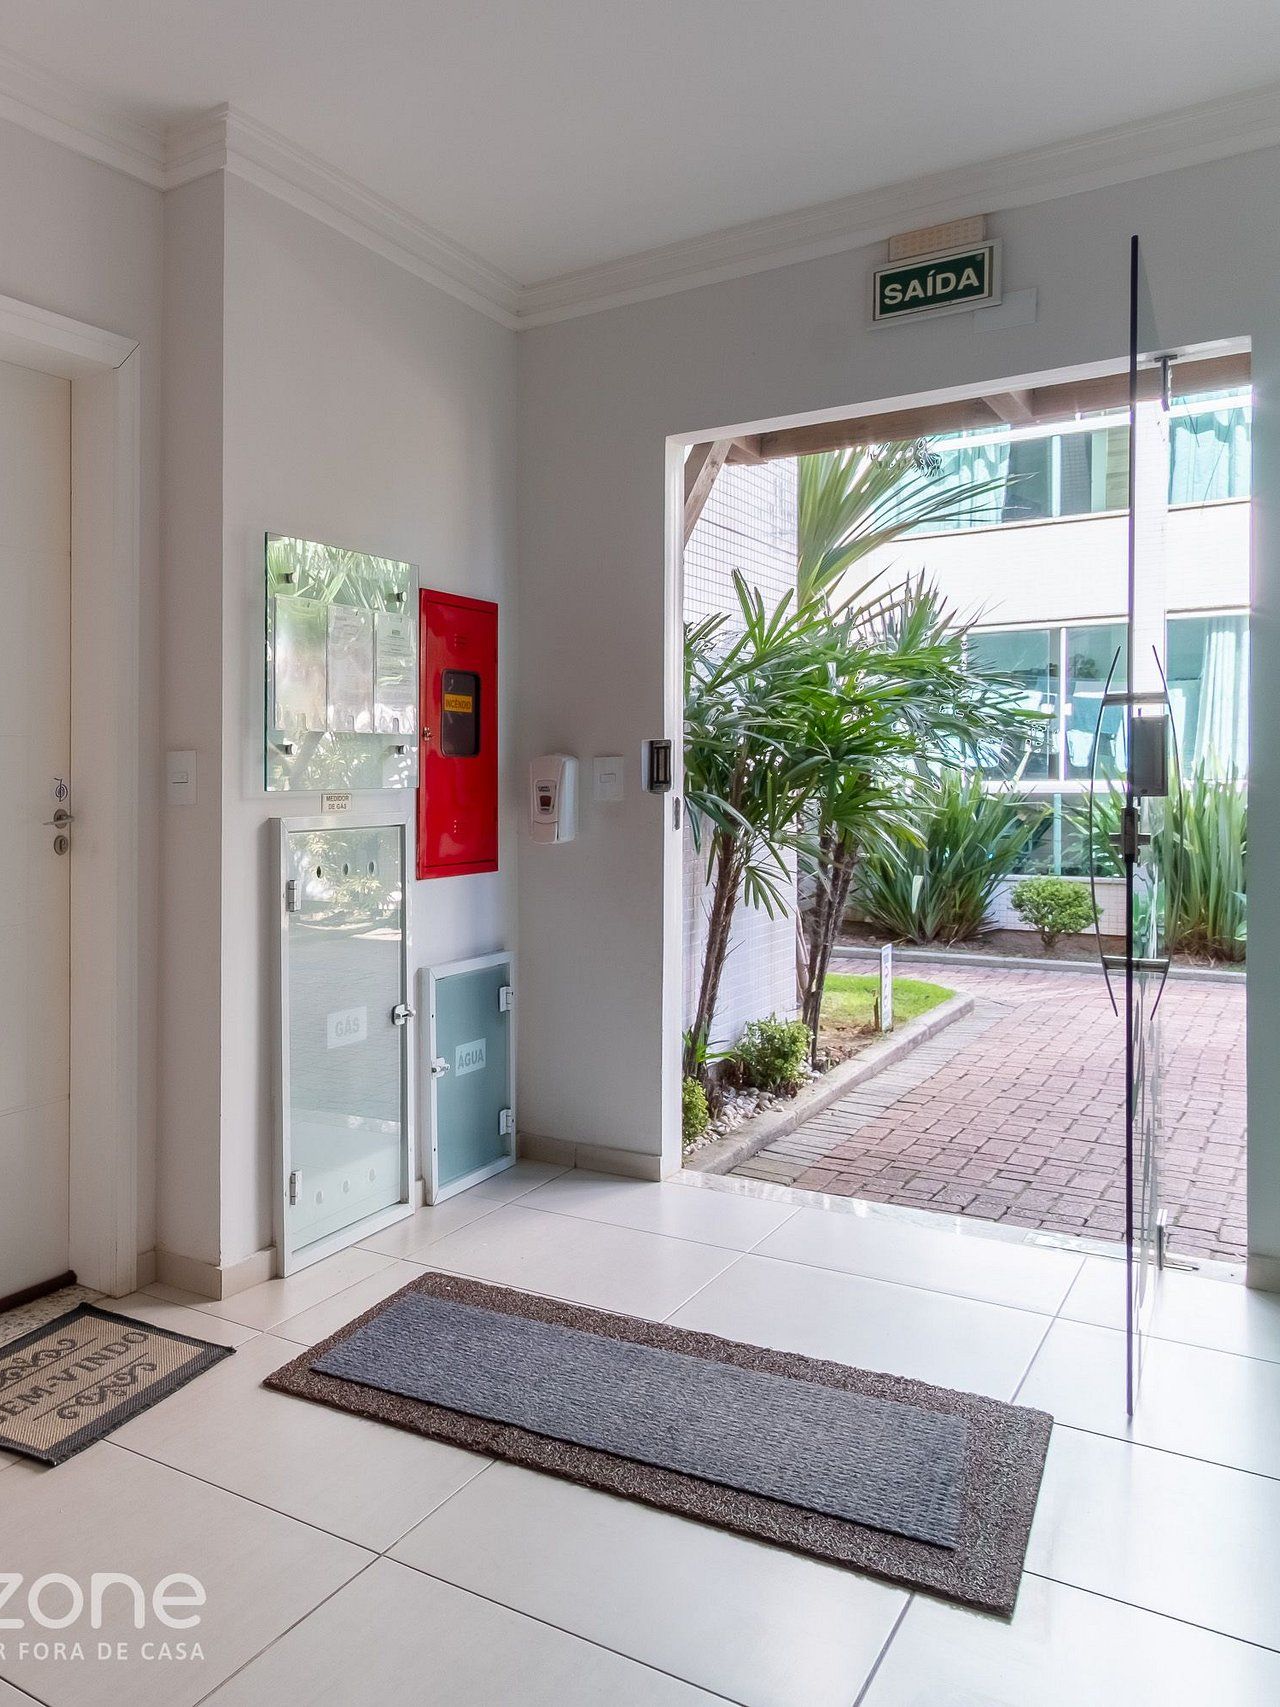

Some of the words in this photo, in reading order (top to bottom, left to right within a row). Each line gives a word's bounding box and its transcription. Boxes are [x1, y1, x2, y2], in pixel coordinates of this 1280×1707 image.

[883, 267, 980, 305] SAÍDA
[334, 1016, 360, 1038] GÁS
[457, 1048, 485, 1070] ÁGUA
